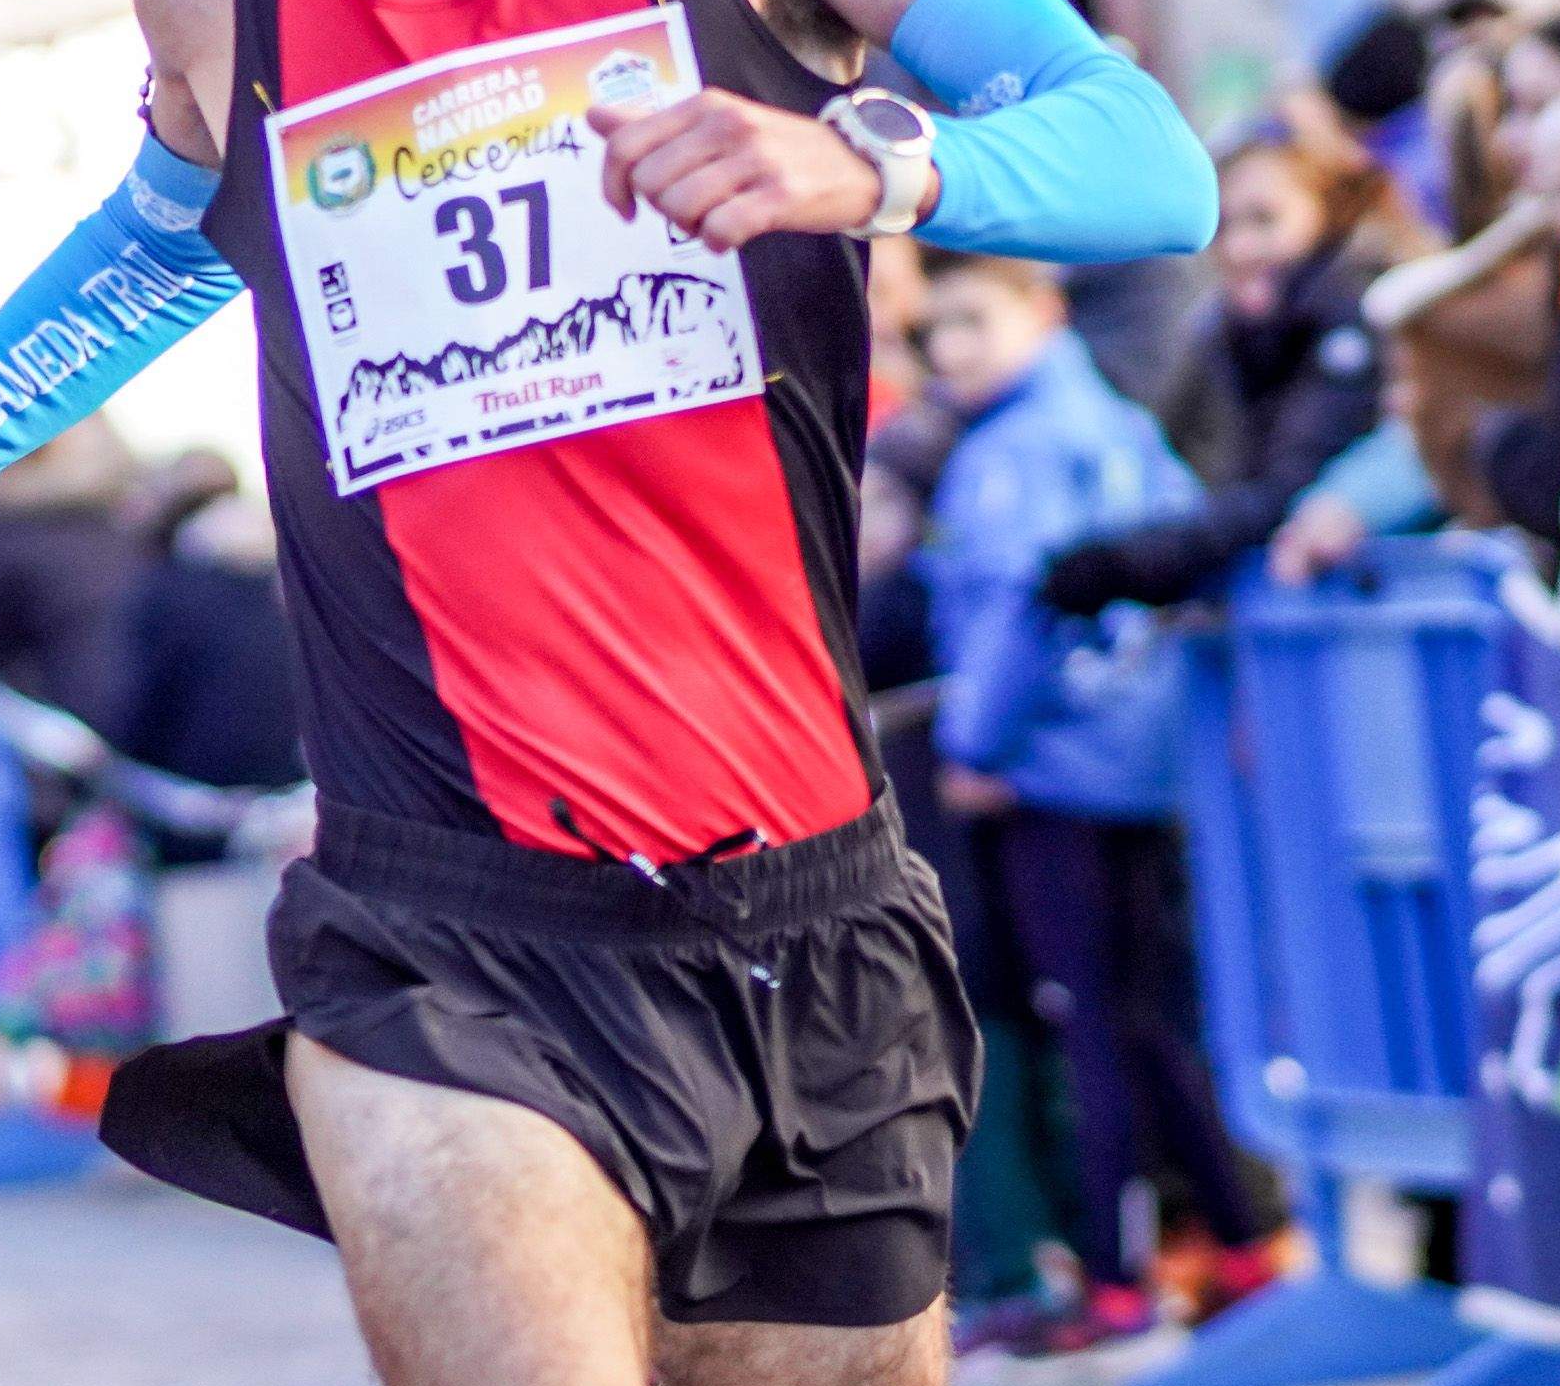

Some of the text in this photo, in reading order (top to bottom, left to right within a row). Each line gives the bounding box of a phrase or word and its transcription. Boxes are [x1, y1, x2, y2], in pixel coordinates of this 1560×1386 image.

[412, 65, 520, 126] CARRERA
[415, 81, 546, 154] NAVIDAD
[433, 179, 553, 307] 37
[474, 371, 603, 414] Trail Run
